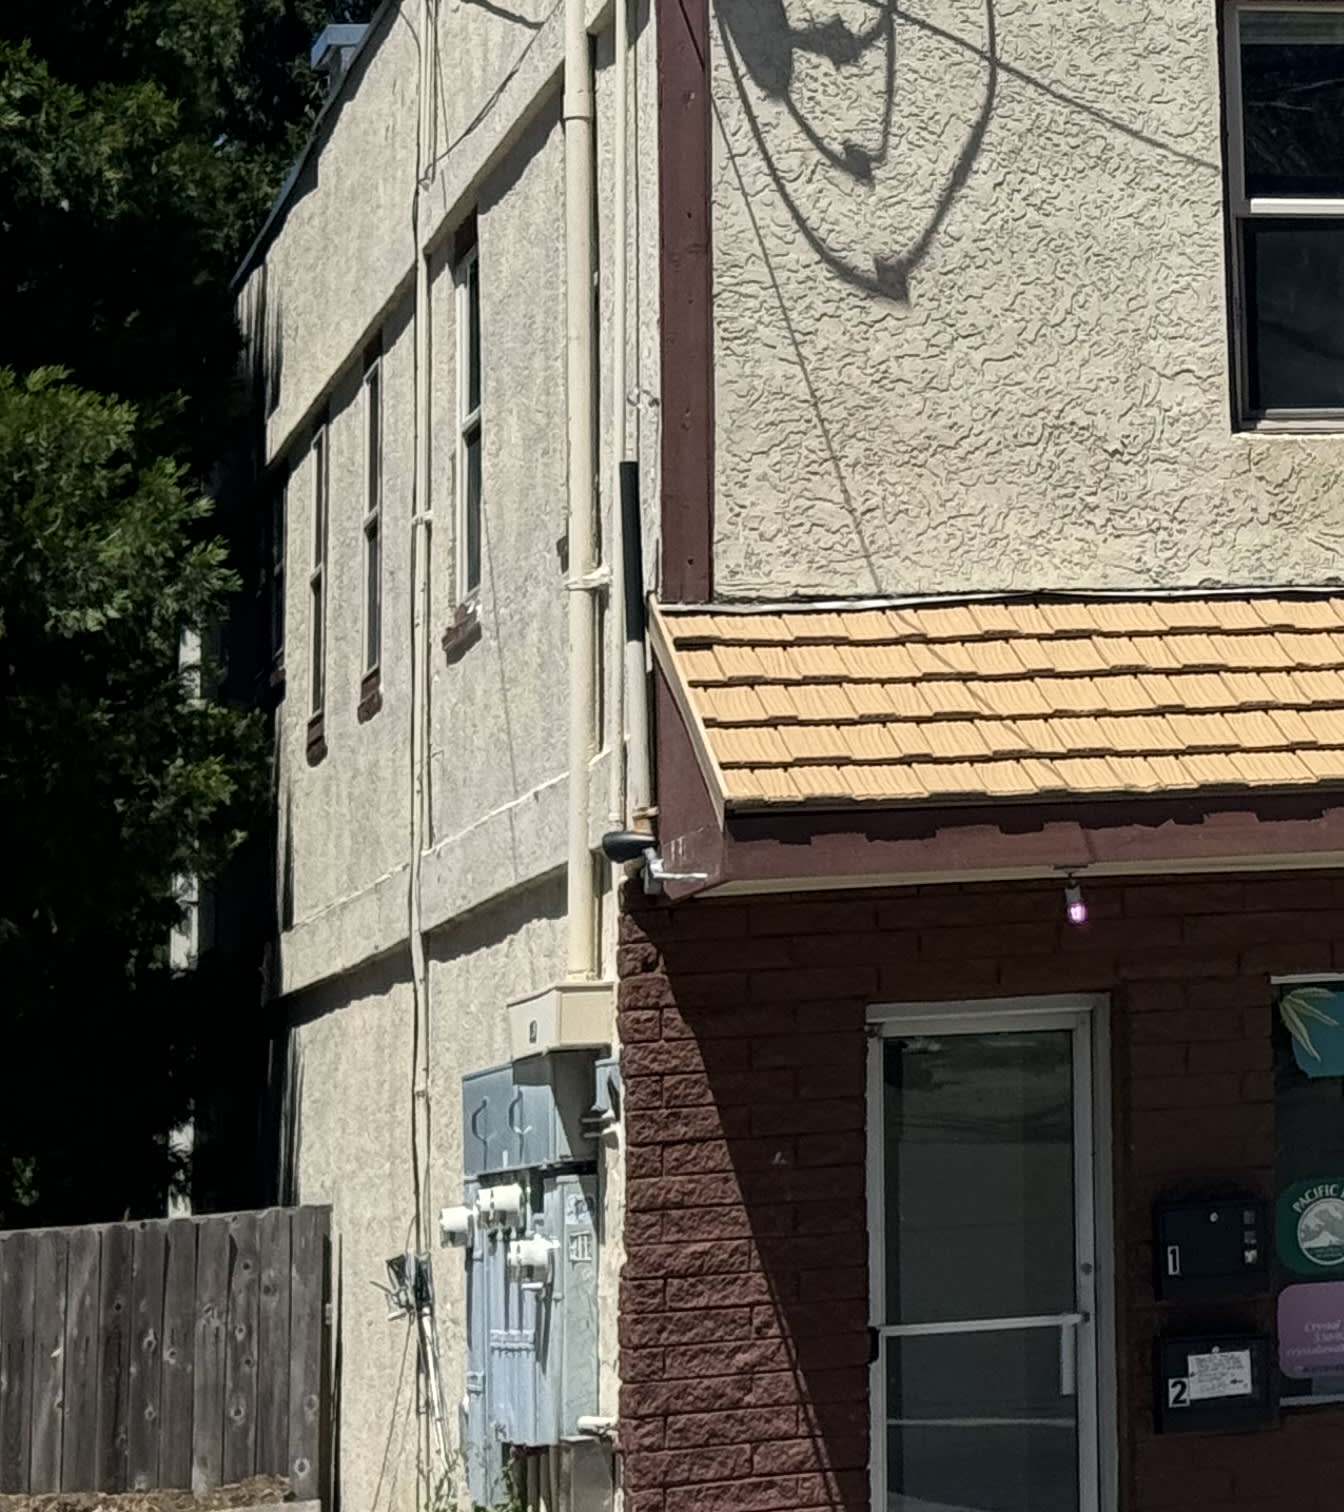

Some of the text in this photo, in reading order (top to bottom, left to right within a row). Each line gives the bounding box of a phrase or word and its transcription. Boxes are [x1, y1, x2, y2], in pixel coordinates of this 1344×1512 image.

[1292, 1184, 1339, 1213] PACIFIC
[1169, 1248, 1179, 1272] 1
[1171, 1379, 1187, 1405] 2
